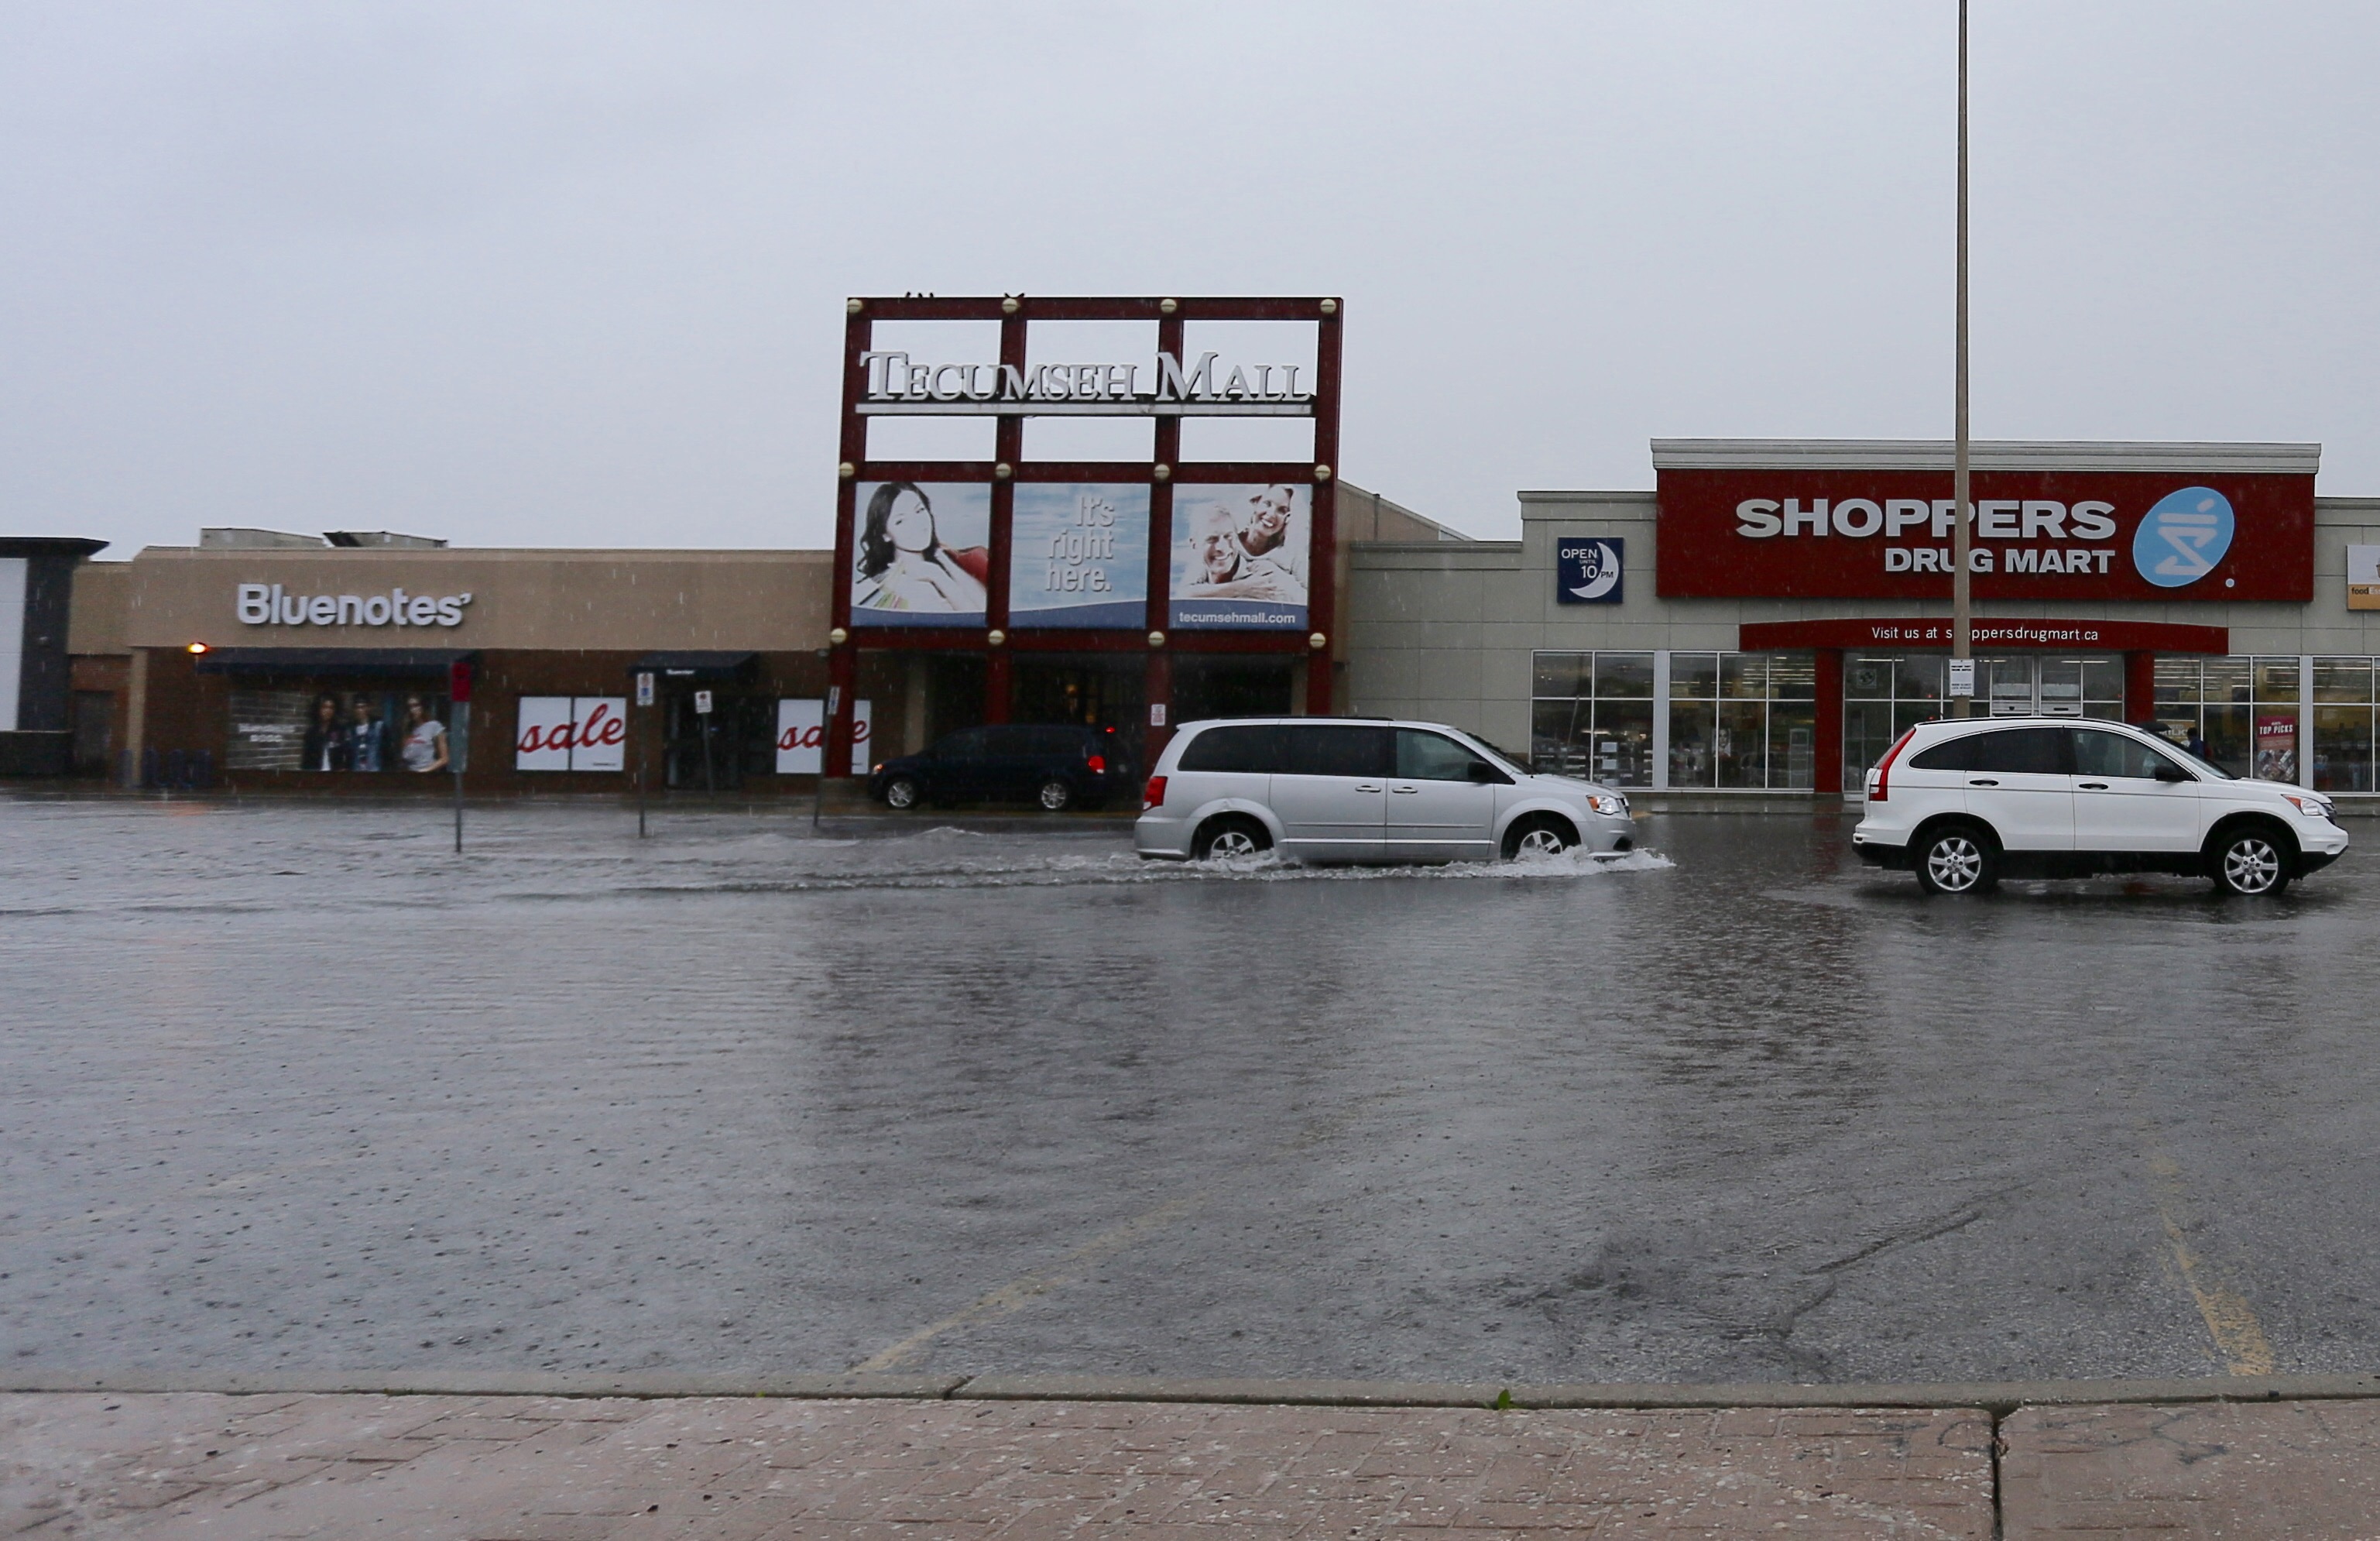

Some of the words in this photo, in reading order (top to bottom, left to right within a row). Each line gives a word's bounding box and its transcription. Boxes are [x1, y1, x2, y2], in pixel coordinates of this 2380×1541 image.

[859, 351, 1137, 400] TECUMSEH
[1155, 352, 1311, 401] MALL
[1075, 495, 1115, 527] It's
[1736, 498, 2116, 540] SHOPPERS
[1048, 527, 1114, 566] right
[1561, 548, 1597, 559] OPEN
[1885, 547, 1994, 572] DRUG
[2005, 549, 2116, 573] MART
[1045, 559, 1113, 592] here.
[1581, 565, 1597, 578] 10
[1179, 612, 1295, 623] tecumsehmall.com
[1871, 626, 1898, 639] Visit
[1905, 629, 1919, 639] us
[1926, 627, 1937, 639] at
[1946, 626, 2098, 642] sppersdrugmart.ca
[517, 703, 627, 753] sale
[777, 720, 872, 750] sae
[2259, 726, 2272, 735] TOP
[2274, 725, 2293, 733] PICKS
